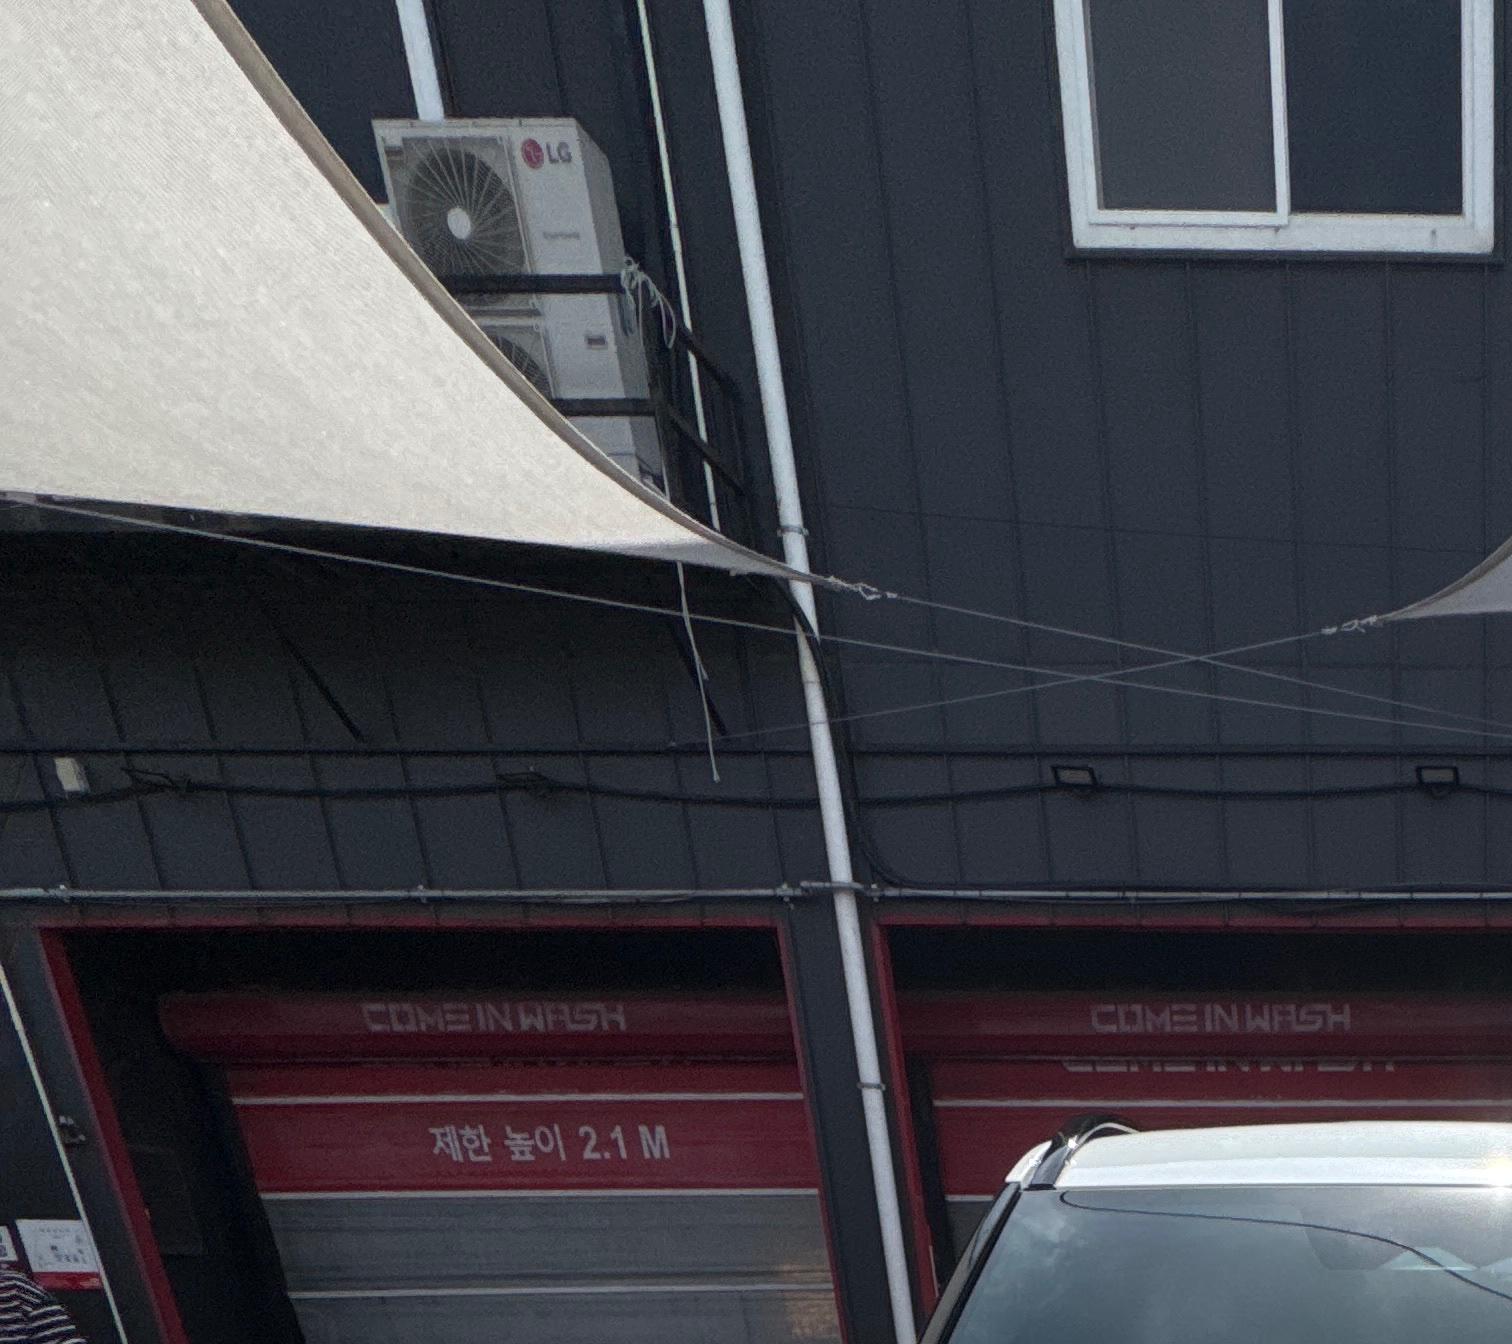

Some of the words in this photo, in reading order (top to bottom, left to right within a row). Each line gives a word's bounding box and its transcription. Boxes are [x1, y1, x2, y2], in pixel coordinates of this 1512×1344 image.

[546, 142, 572, 164] LG
[362, 1002, 472, 1033] COME
[475, 1002, 513, 1032] IN
[517, 1002, 627, 1032] WASH
[1091, 1003, 1198, 1033] COME
[1204, 1003, 1239, 1032] IN
[1244, 1003, 1351, 1033] WASH
[428, 1124, 493, 1163] 제한
[504, 1123, 567, 1162] 높이
[578, 1124, 628, 1161] 2.1
[638, 1124, 671, 1160] M
